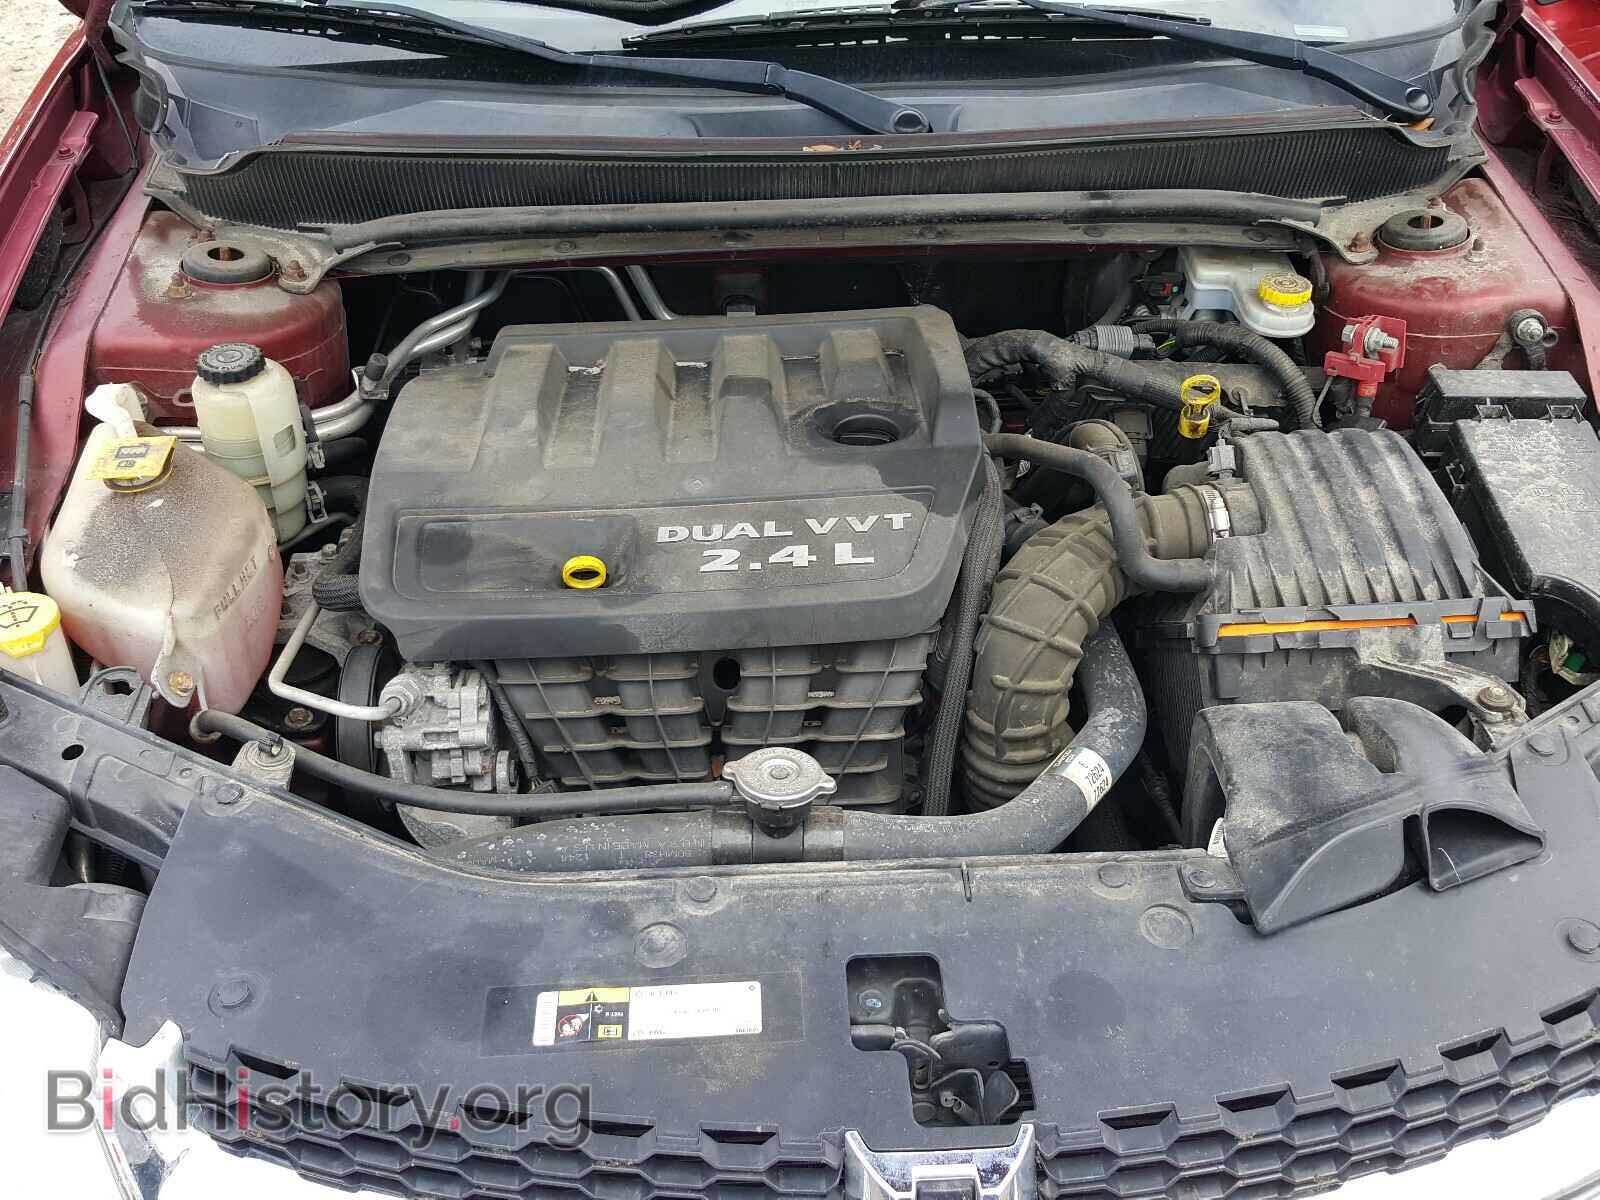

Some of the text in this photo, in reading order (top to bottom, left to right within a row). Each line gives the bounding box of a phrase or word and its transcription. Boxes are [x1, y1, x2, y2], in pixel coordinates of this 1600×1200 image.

[656, 512, 913, 544] DUAL VVT
[700, 542, 875, 572] 2.4 L
